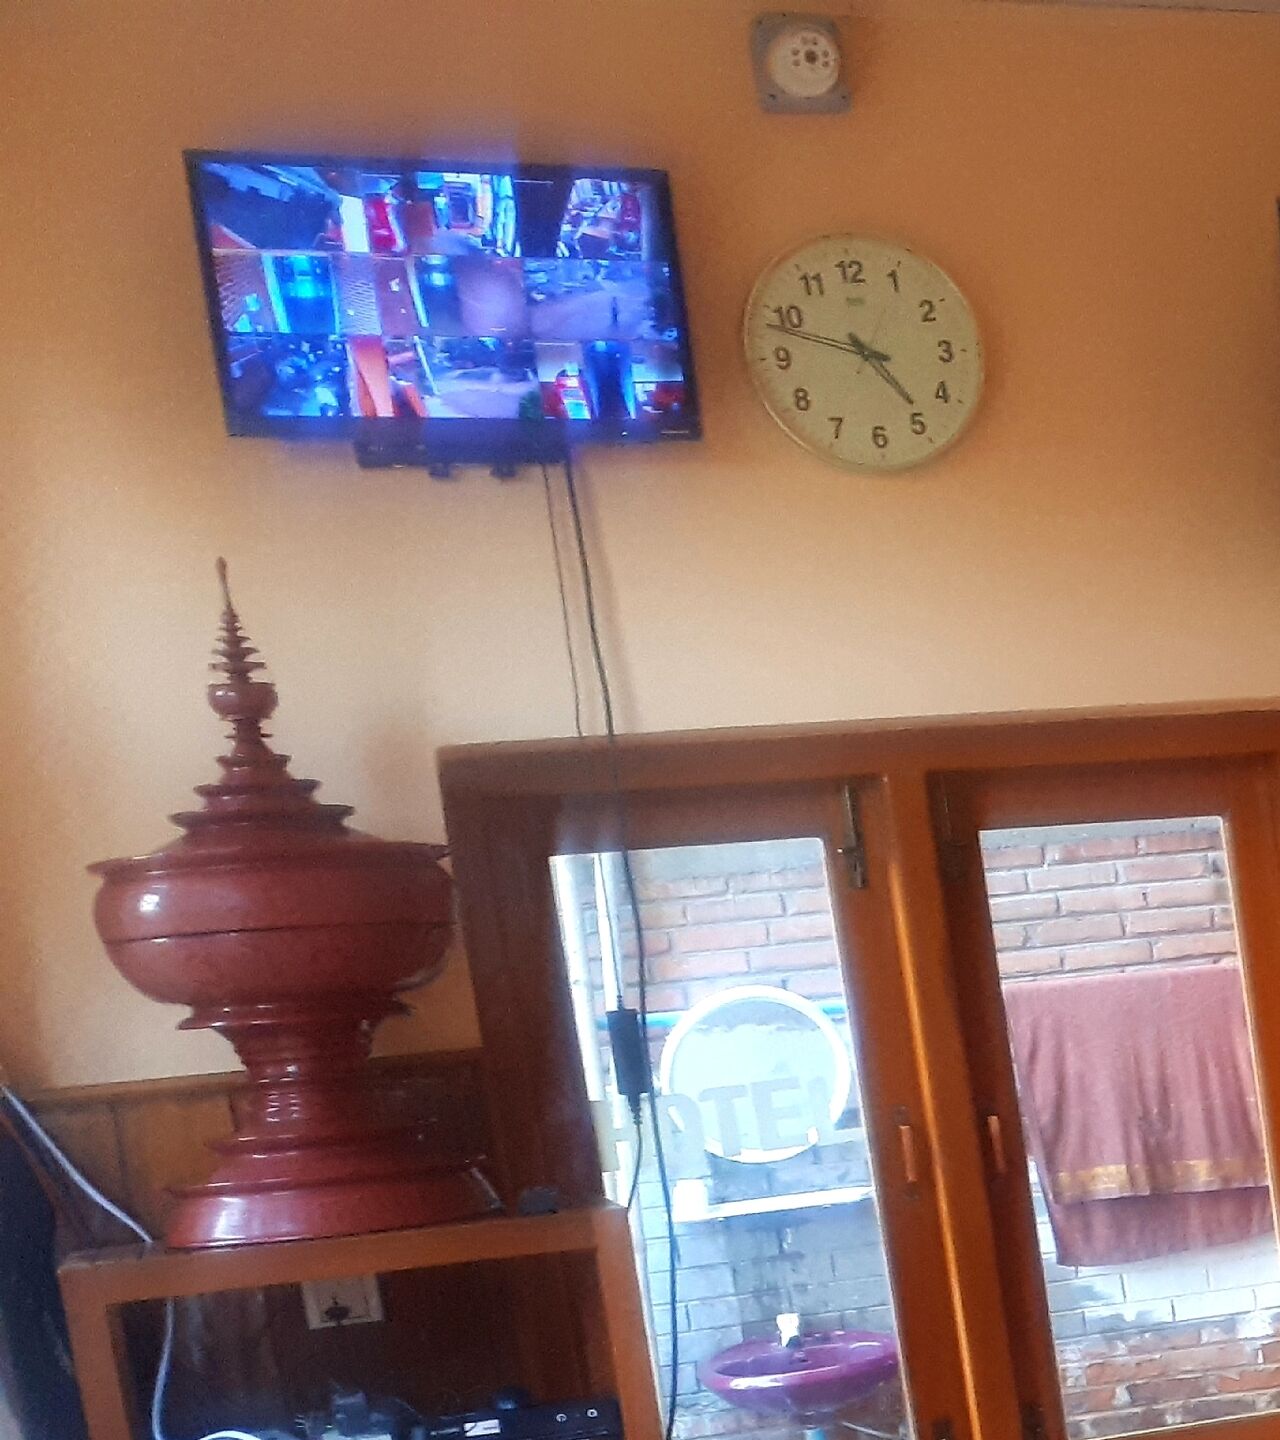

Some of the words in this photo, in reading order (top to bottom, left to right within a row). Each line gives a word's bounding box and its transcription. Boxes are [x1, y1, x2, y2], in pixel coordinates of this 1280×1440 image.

[800, 271, 824, 295] 11
[835, 260, 866, 283] 12
[887, 269, 900, 293] 1
[773, 305, 803, 329] 10
[919, 299, 936, 323] 2
[774, 346, 792, 370] 9
[937, 339, 953, 363] 3
[793, 388, 811, 411] 8
[935, 381, 951, 404] 4
[828, 417, 843, 439] 7
[910, 412, 926, 435] 5
[871, 426, 888, 448] 6
